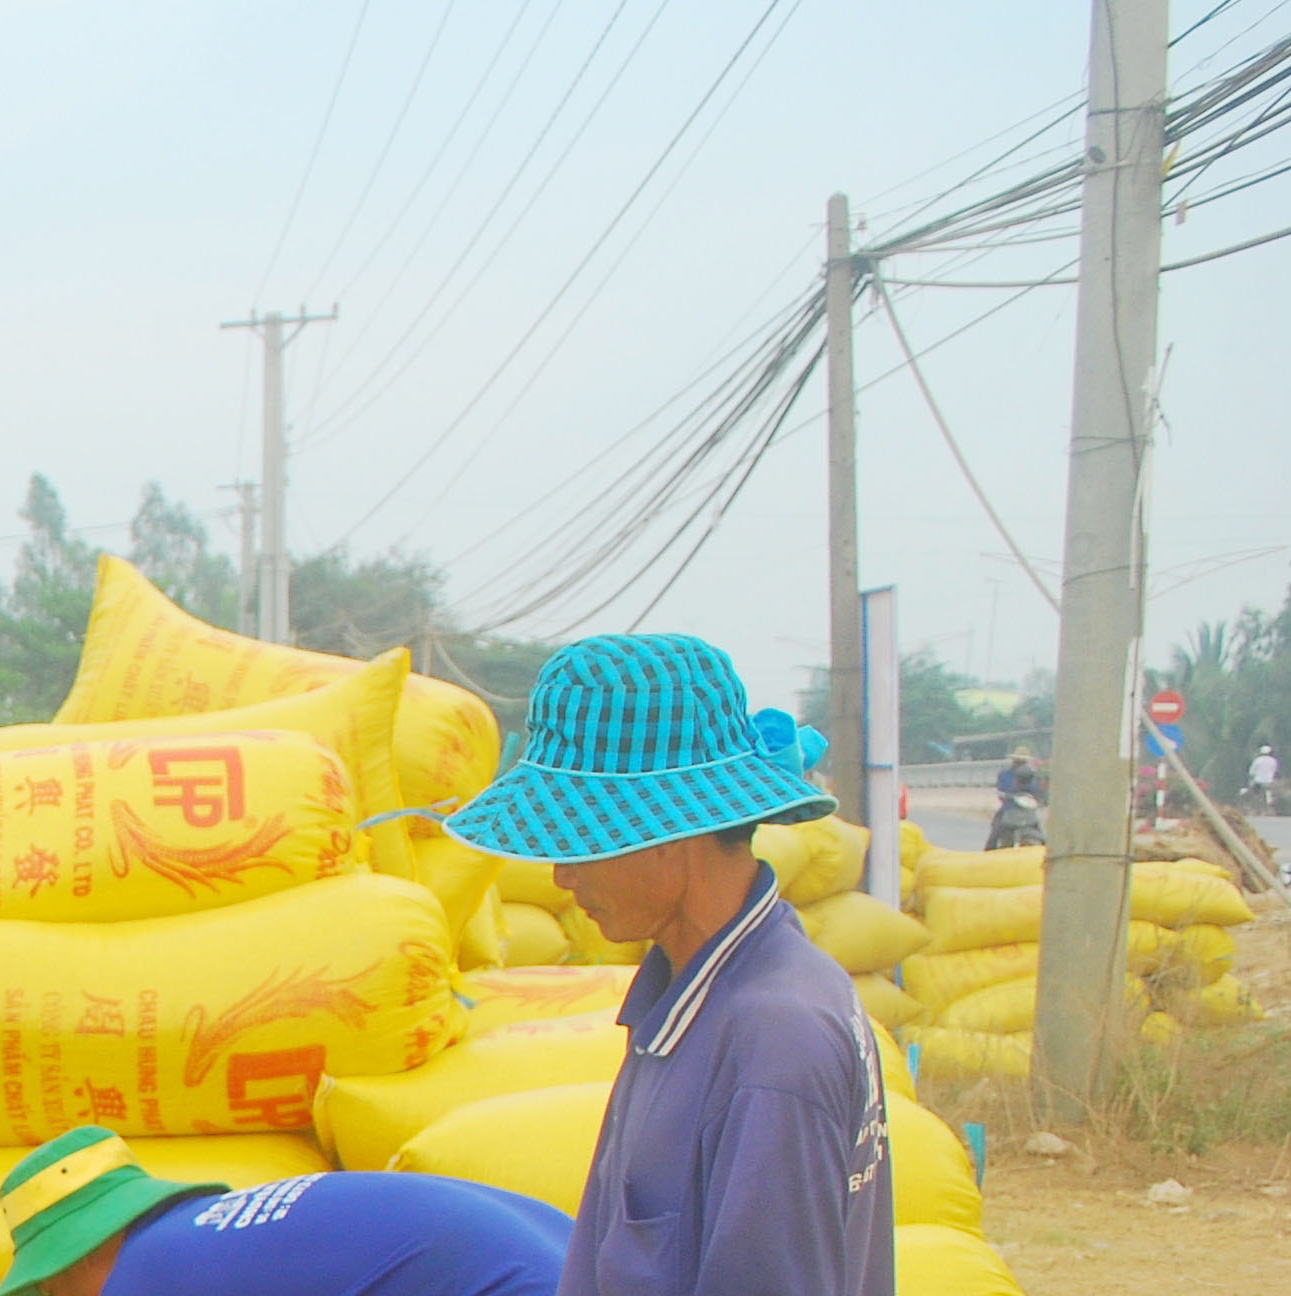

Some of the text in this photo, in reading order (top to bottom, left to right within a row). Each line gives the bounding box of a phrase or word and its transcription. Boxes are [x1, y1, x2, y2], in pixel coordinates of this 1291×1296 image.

[75, 781, 95, 819] PHAT
[74, 826, 94, 856] CO.
[72, 862, 92, 897] LTD
